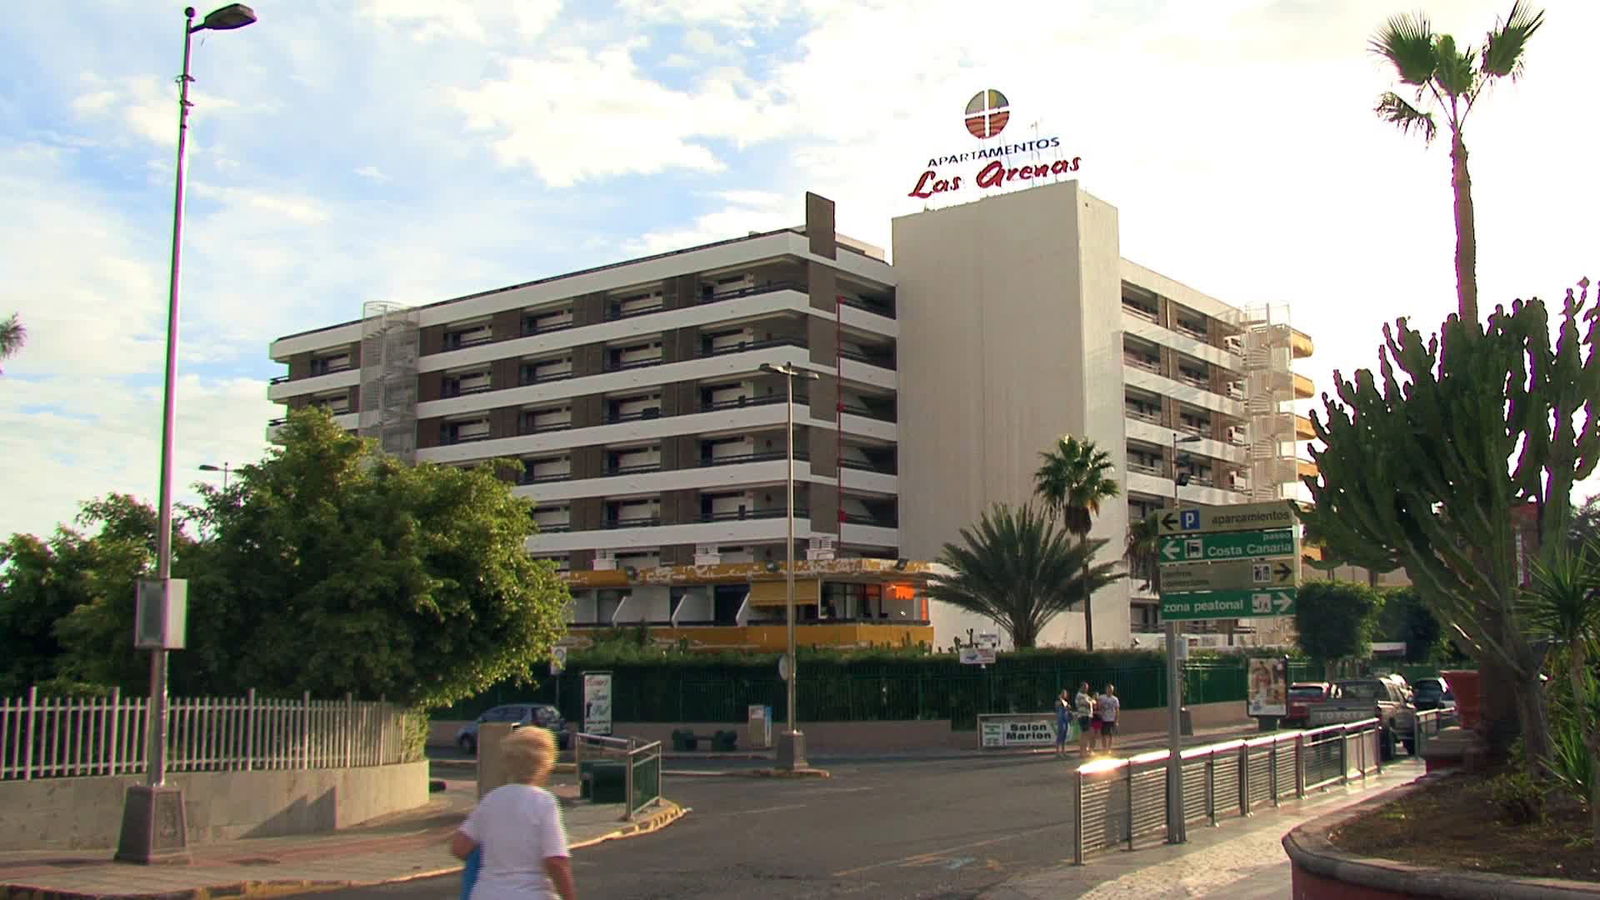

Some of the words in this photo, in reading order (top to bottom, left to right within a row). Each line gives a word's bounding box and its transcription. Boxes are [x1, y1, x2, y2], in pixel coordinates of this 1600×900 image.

[928, 137, 1060, 167] APARTAMENTOS
[908, 170, 962, 198] Las
[1212, 511, 1290, 525] aparcamientos
[1263, 533, 1291, 541] paseo
[1207, 546, 1242, 557] Costa
[1246, 543, 1291, 554] Canaria
[1163, 604, 1190, 613] zona
[1194, 600, 1243, 613] peatonal
[1320, 711, 1366, 720] TOYOTA
[1010, 723, 1047, 732] Salon
